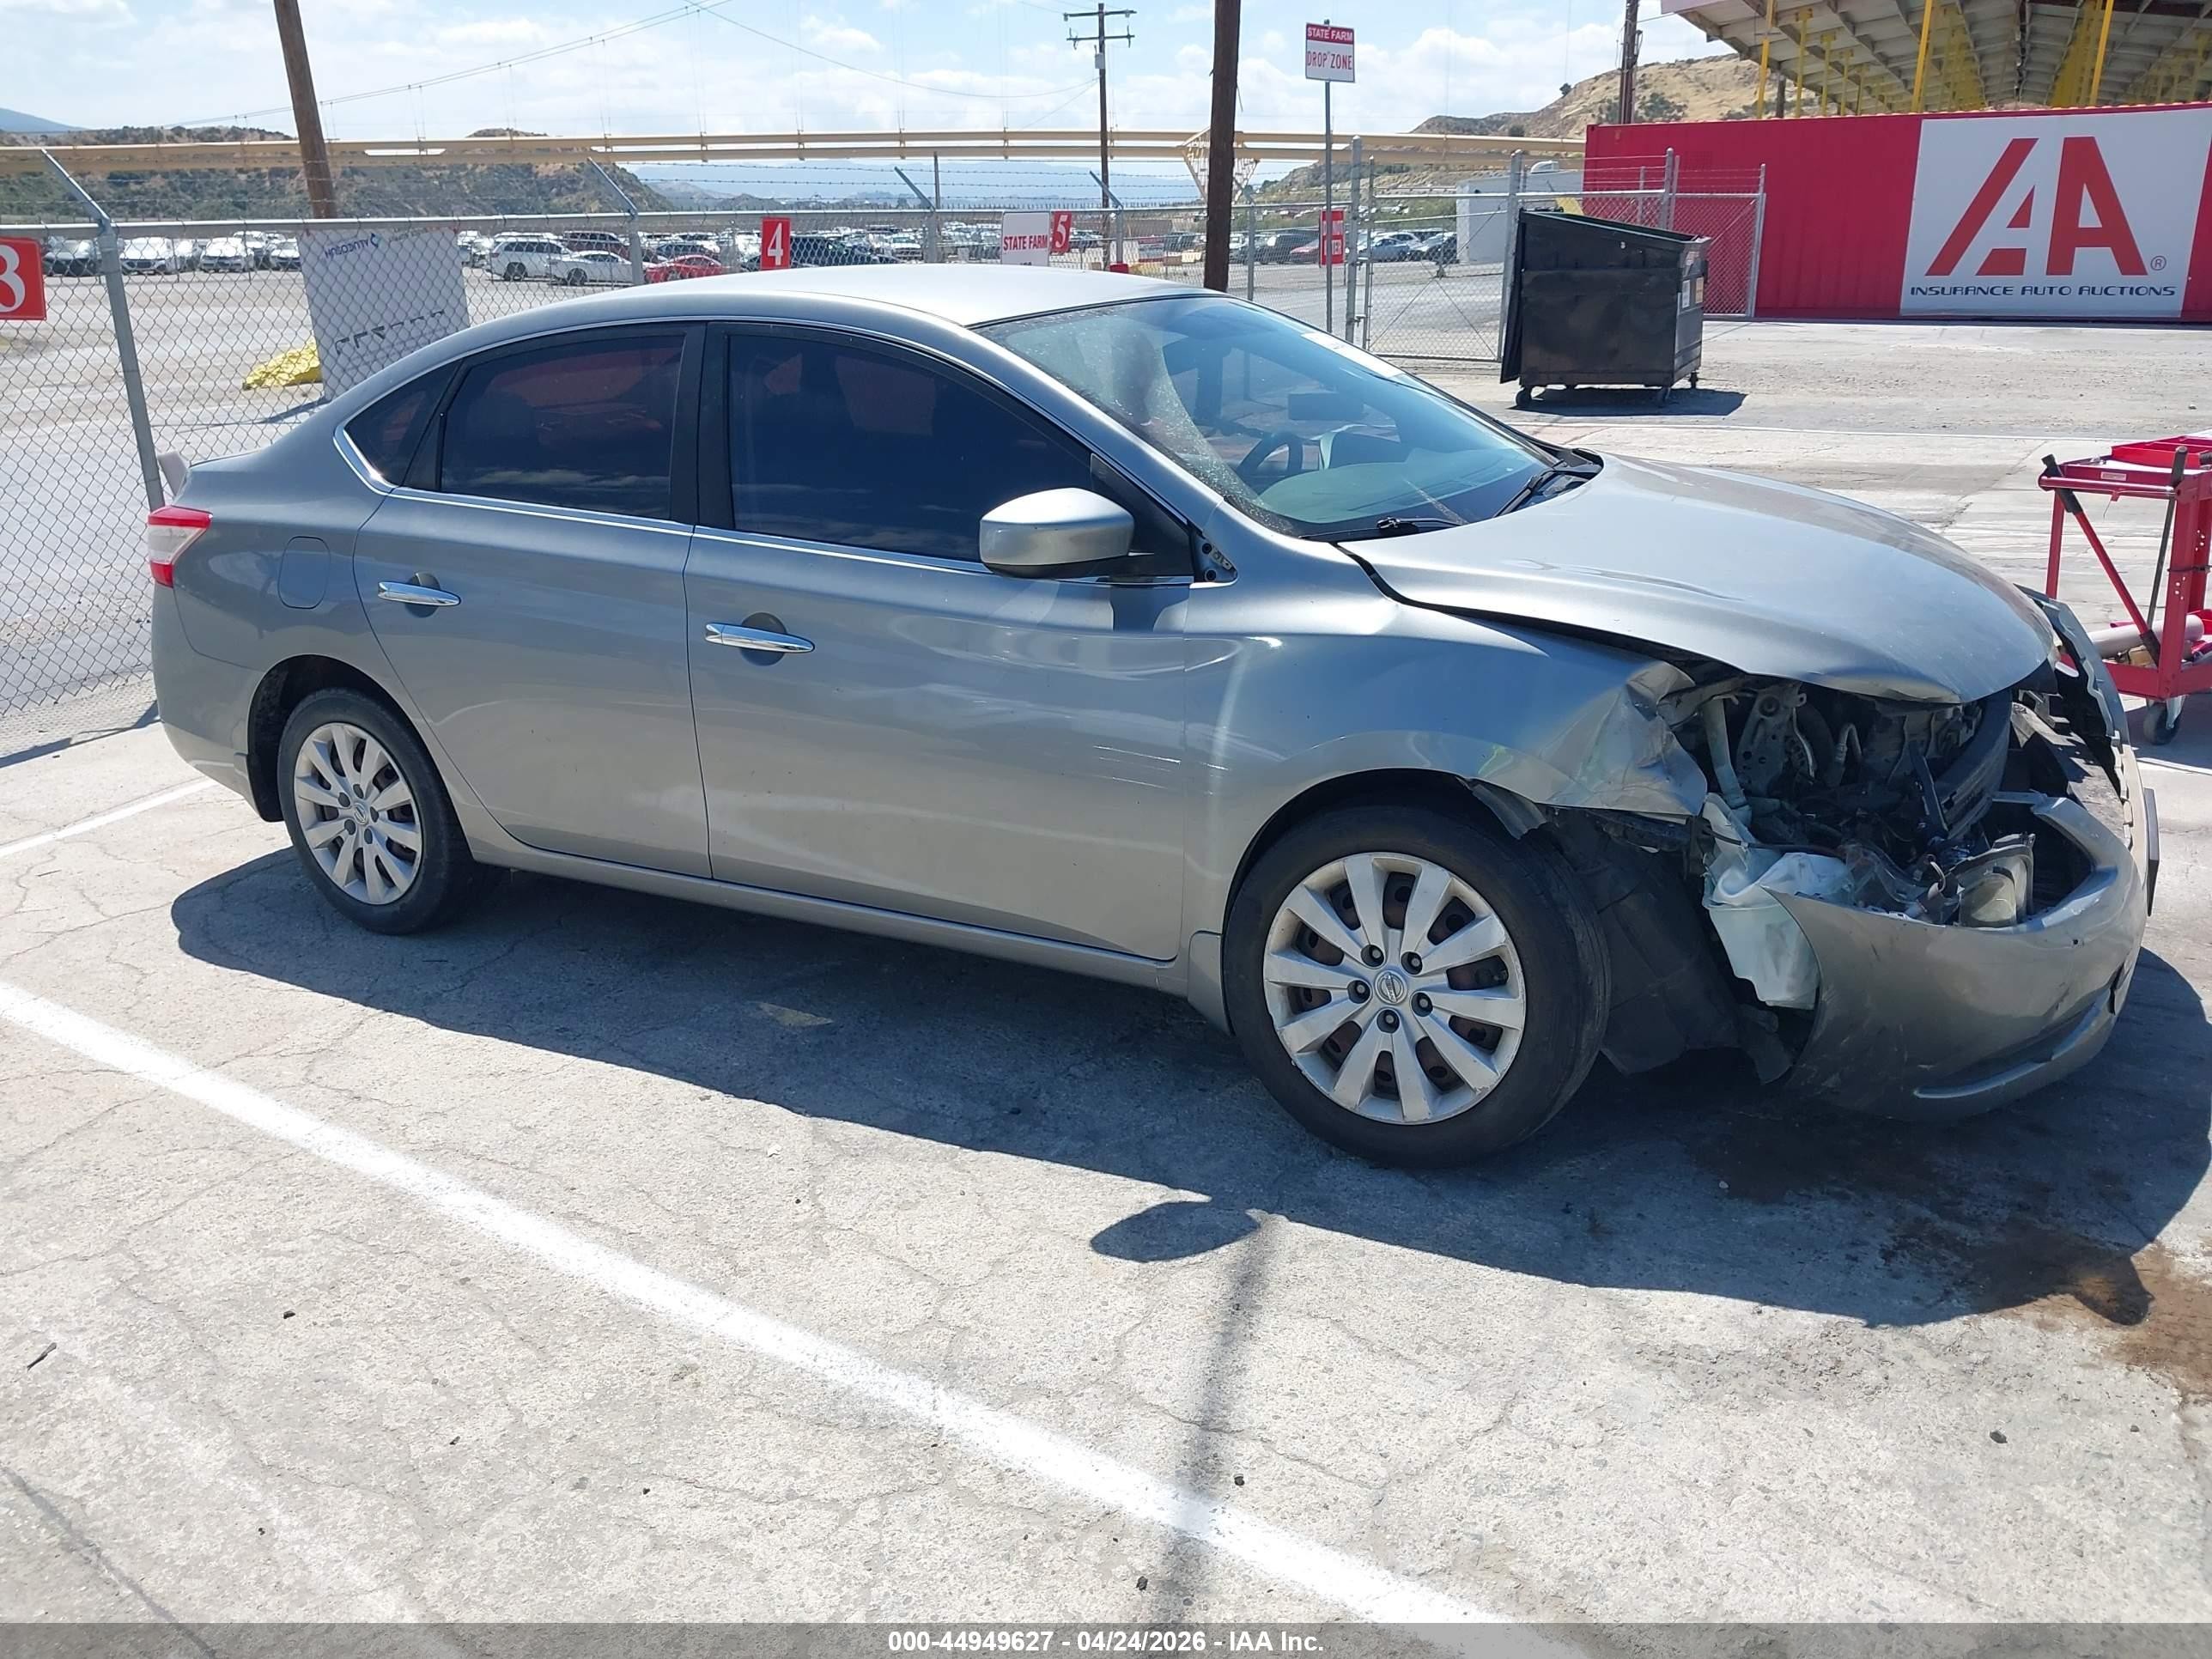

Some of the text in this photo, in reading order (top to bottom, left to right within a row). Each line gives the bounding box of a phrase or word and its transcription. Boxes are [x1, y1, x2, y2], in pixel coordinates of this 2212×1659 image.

[1308, 27, 1352, 41] STATE FARM
[1308, 52, 1352, 70] DROP ZONE
[1055, 215, 1067, 248] 5
[767, 222, 784, 266] 4
[1004, 234, 1048, 251] STATE FARM
[1910, 285, 2177, 296] INSURANCE AUTO AUCTIONS
